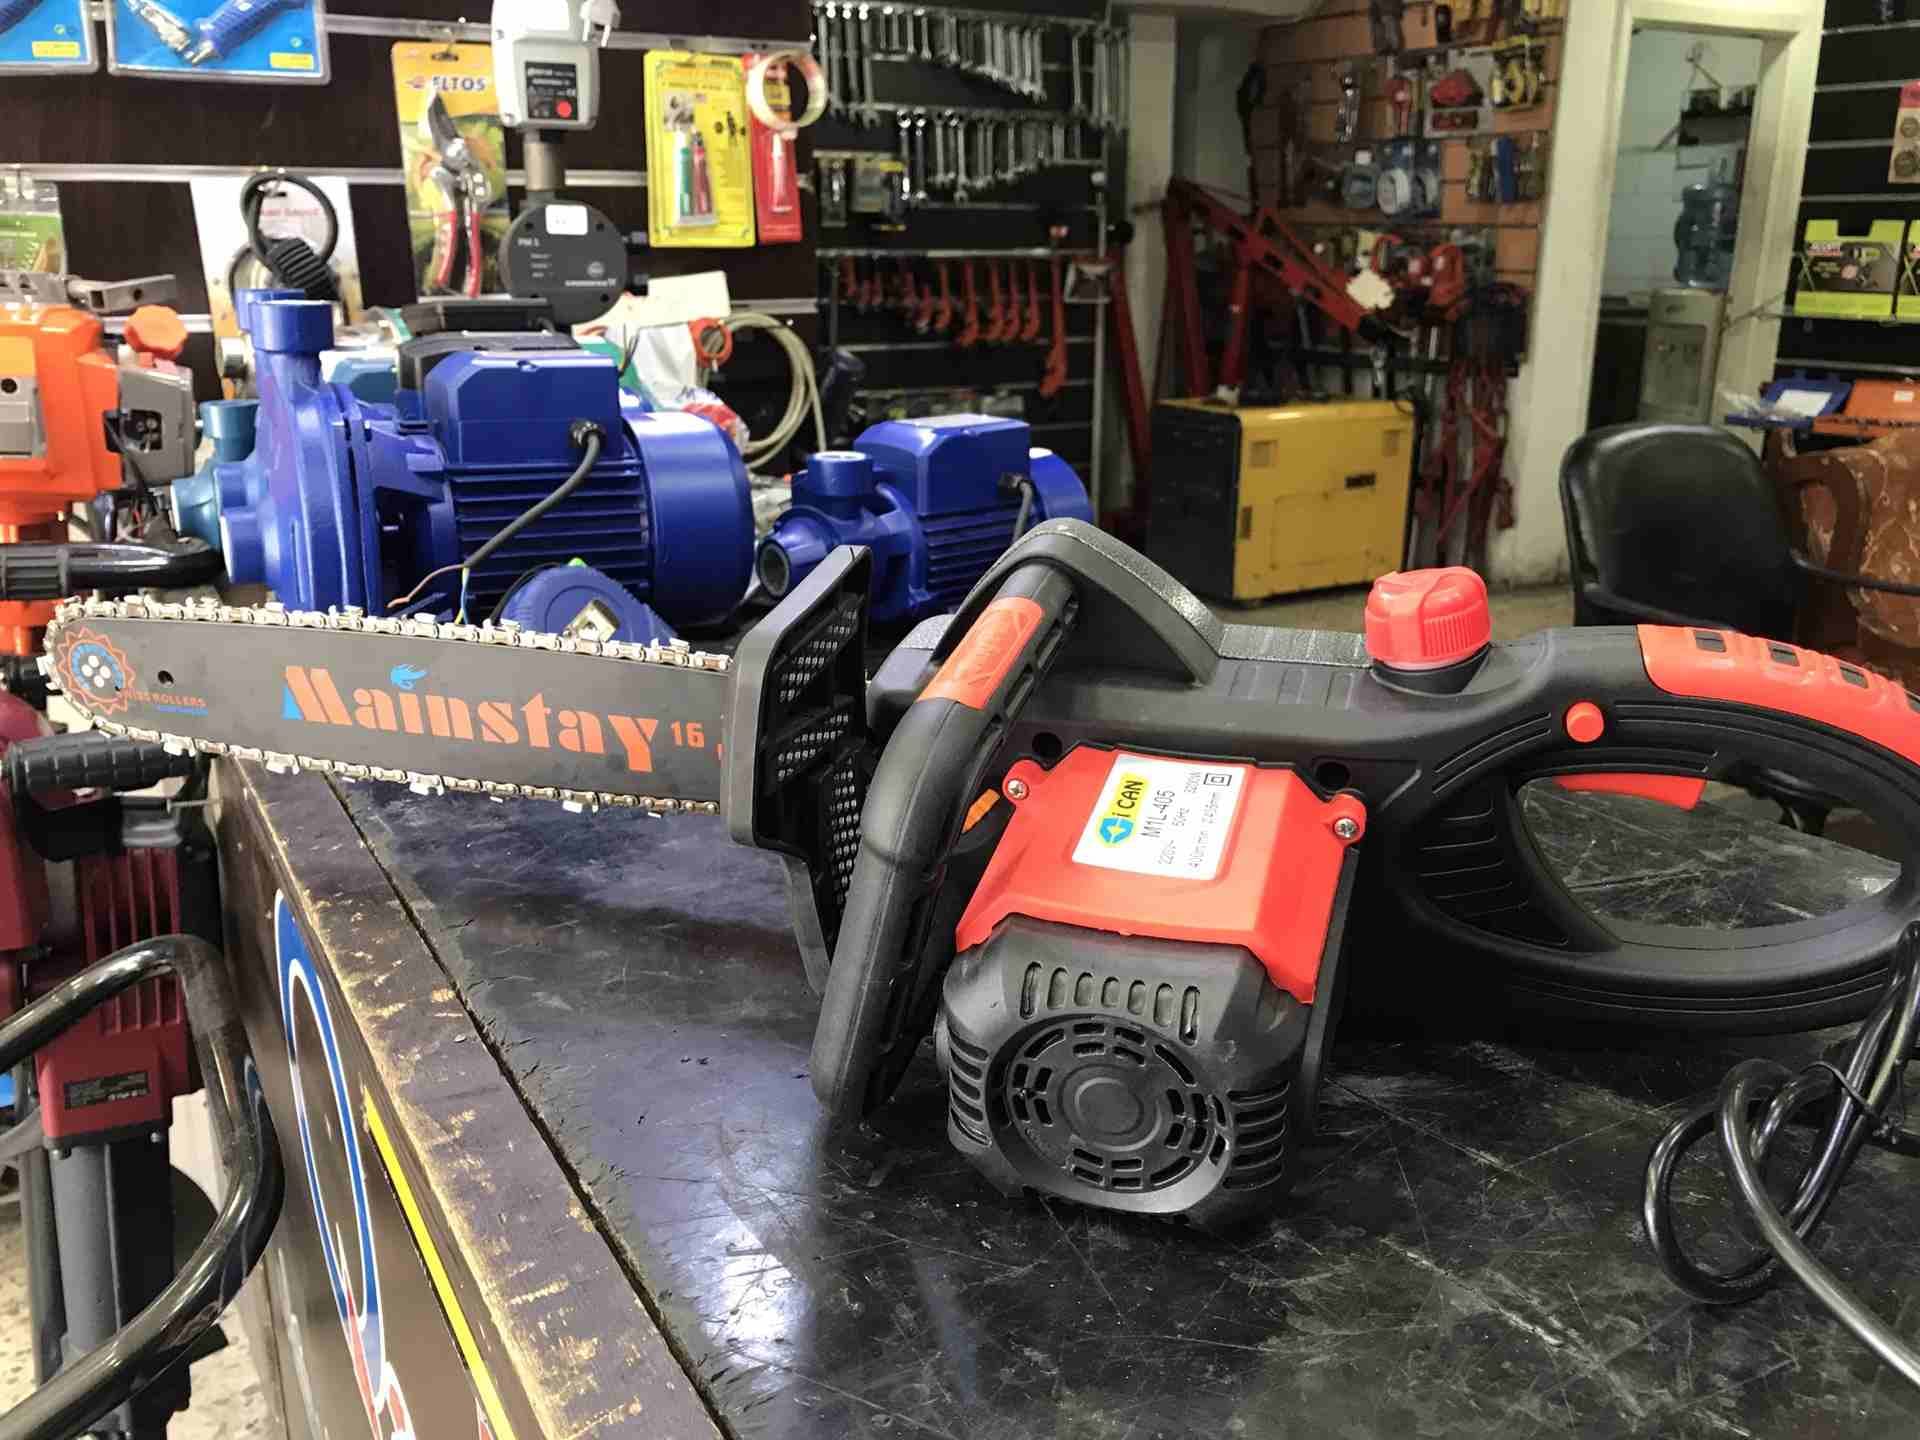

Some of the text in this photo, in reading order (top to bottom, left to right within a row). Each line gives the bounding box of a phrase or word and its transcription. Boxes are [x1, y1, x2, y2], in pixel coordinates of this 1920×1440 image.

[283, 664, 704, 773] Mainstay 16
[1117, 780, 1144, 809] CAN
